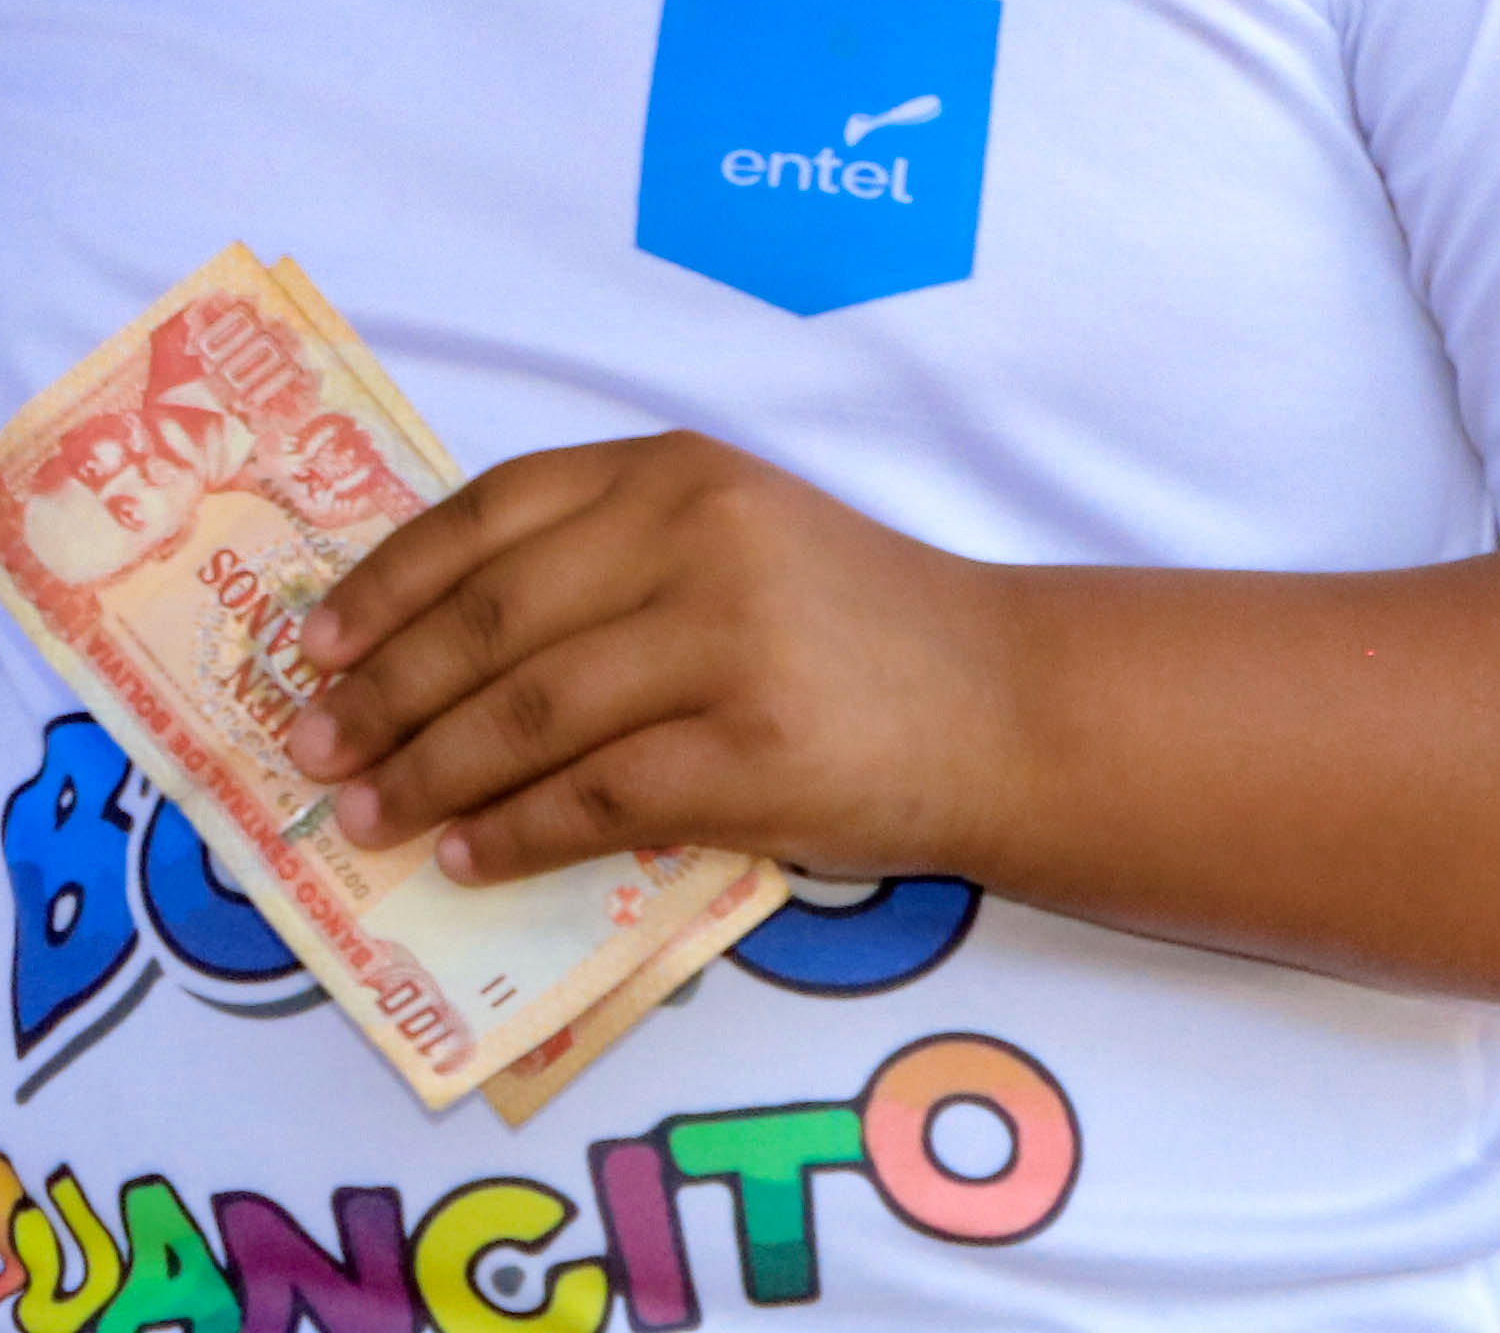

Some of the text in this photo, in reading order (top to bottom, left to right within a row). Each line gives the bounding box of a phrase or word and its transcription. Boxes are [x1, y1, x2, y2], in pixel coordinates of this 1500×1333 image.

[720, 146, 914, 204] entel
[80, 628, 175, 736] BOLIVIA
[165, 728, 210, 775] DE
[197, 763, 306, 887] CENTRAL
[288, 874, 376, 972] BANCO
[374, 974, 458, 1063] 100
